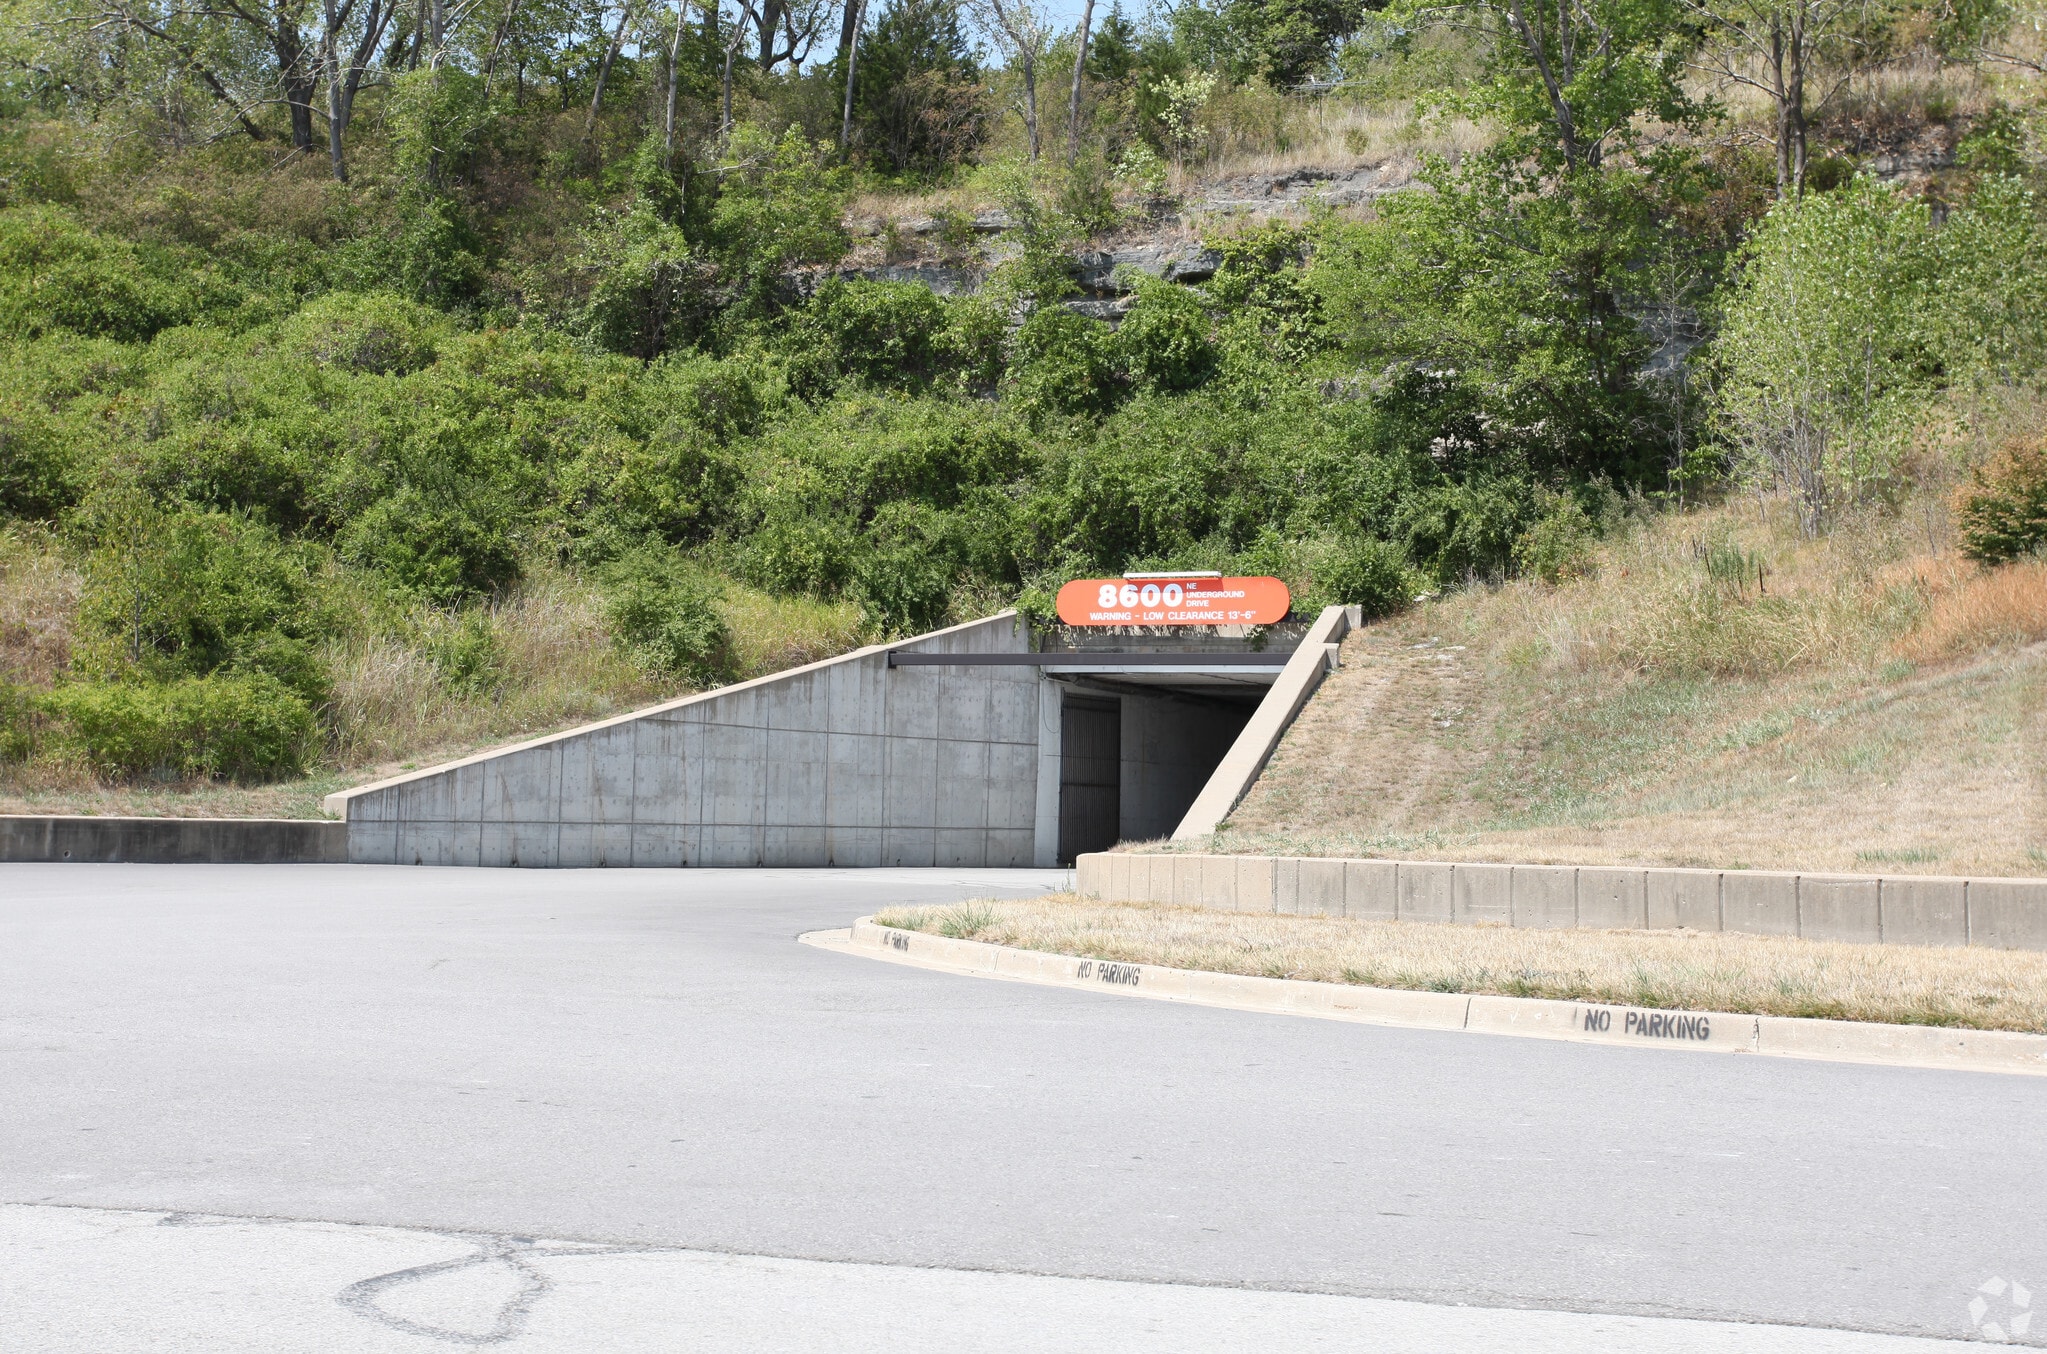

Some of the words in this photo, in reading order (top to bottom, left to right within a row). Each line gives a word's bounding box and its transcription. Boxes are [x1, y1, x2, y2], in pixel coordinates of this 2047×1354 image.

[1098, 584, 1183, 608] 8600
[1090, 612, 1131, 620] WARNING
[1143, 611, 1164, 620] LOW
[1168, 611, 1224, 620] CLEARANCE
[1077, 961, 1092, 979] NO
[1097, 963, 1141, 986] PARKING
[1584, 1009, 1611, 1032] NO
[1625, 1011, 1710, 1041] PARKING
